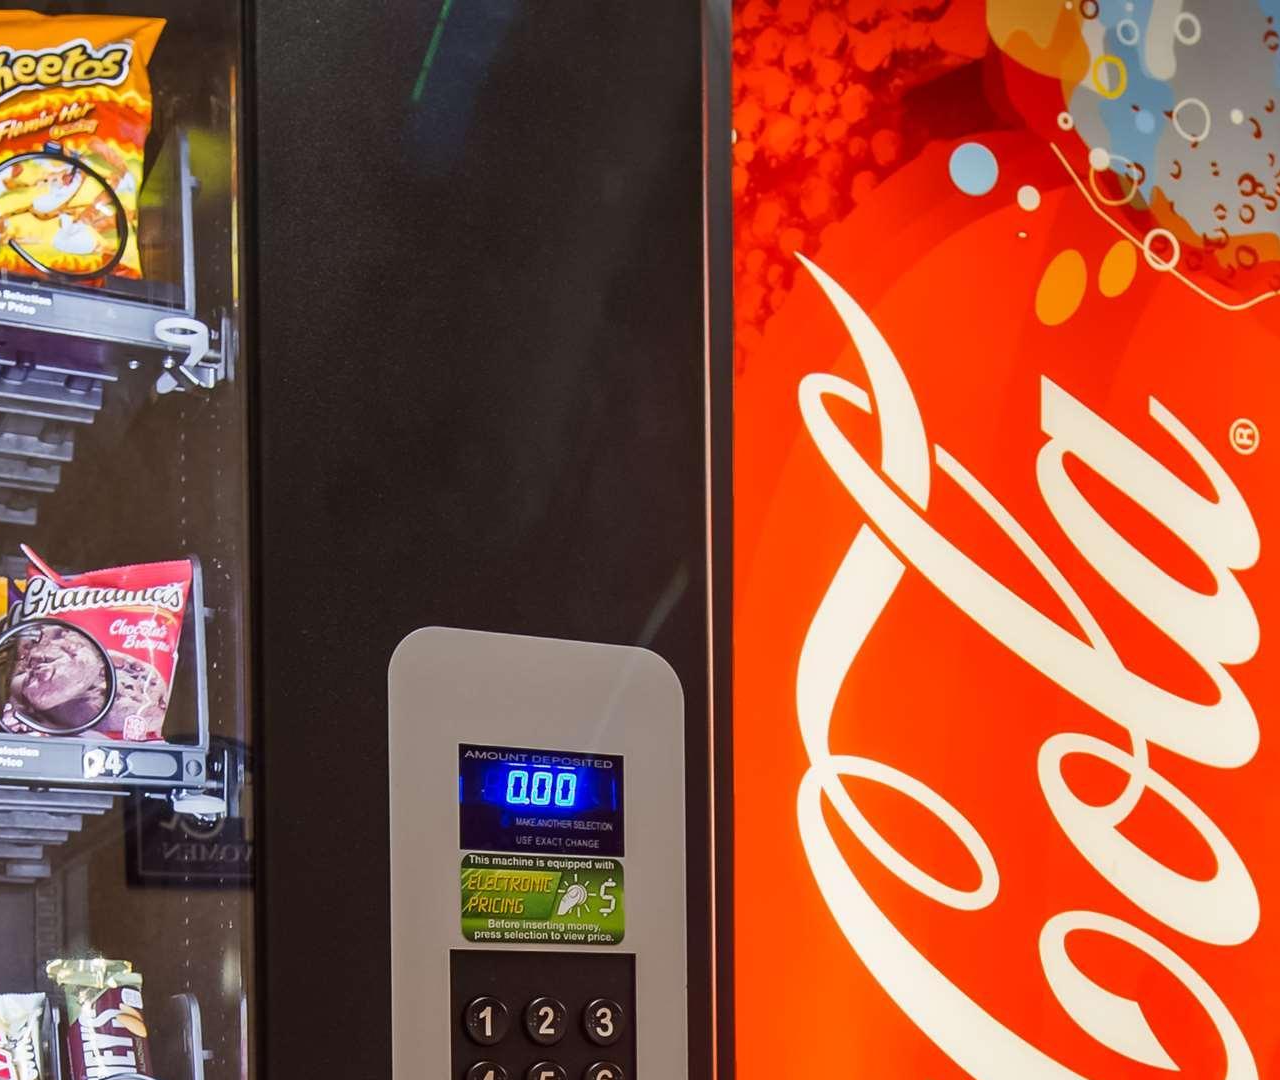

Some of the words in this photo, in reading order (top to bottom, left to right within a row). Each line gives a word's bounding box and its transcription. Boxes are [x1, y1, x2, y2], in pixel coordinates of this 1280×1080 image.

[6, 301, 36, 315] Price
[464, 750, 528, 764] AMOUNT
[531, 755, 613, 769] DEPOSITED
[506, 770, 577, 807] 0.00
[573, 820, 613, 831] SELECTION
[535, 836, 562, 847] EXACT
[565, 838, 600, 849] CHANGE
[469, 854, 490, 865] This
[492, 856, 534, 867] machine
[536, 857, 545, 867] is
[547, 858, 592, 870] equipped
[595, 860, 615, 870] with
[468, 873, 554, 893] ELECTRONIC
[467, 896, 525, 914] PRICING
[488, 919, 521, 930] Before
[522, 920, 565, 932] inserting
[567, 923, 601, 933] money,
[474, 930, 502, 941] press
[504, 930, 549, 940] selection
[550, 930, 561, 941] to
[563, 931, 585, 941] view
[587, 932, 615, 944] price.
[478, 1006, 494, 1037] 1
[538, 1006, 555, 1035] 2
[595, 1007, 614, 1037] 3
